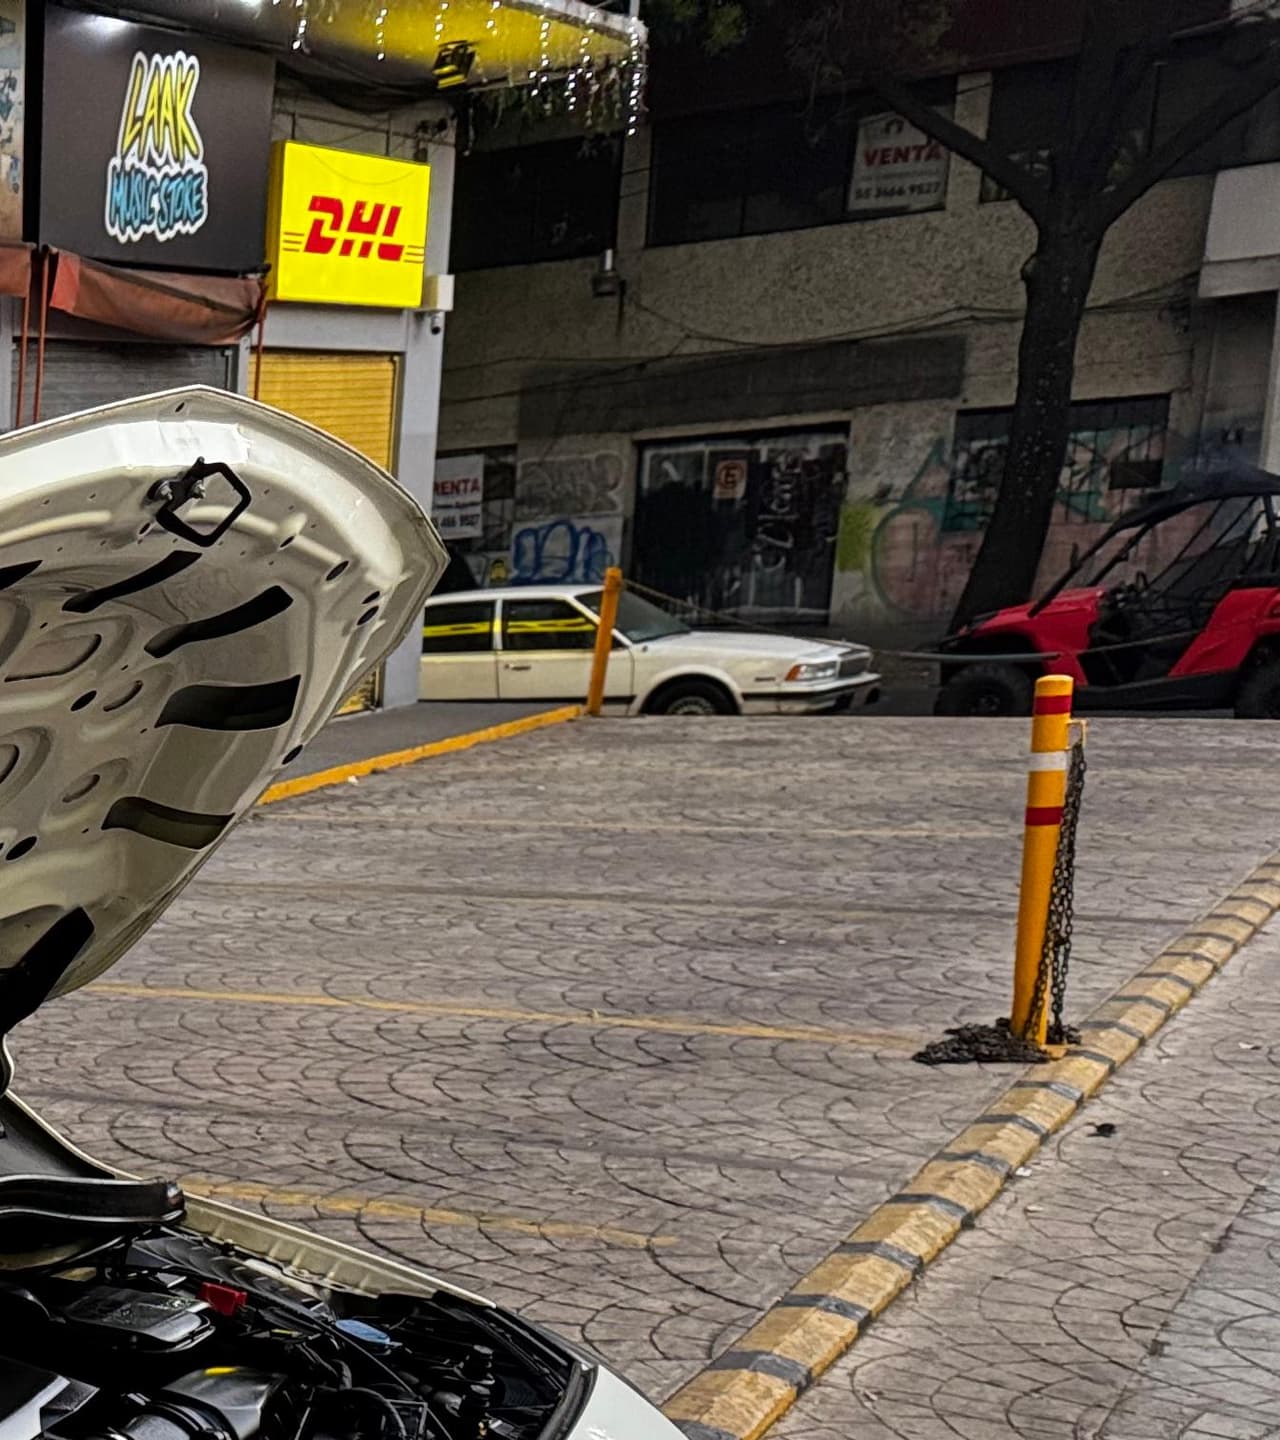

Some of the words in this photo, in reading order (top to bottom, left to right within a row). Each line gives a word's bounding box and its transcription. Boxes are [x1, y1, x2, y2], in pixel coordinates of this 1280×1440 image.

[120, 56, 202, 168] LAAK
[863, 144, 944, 168] VENTA
[109, 163, 158, 235] MUSIC
[157, 168, 206, 234] STORE
[303, 194, 406, 262] DHL
